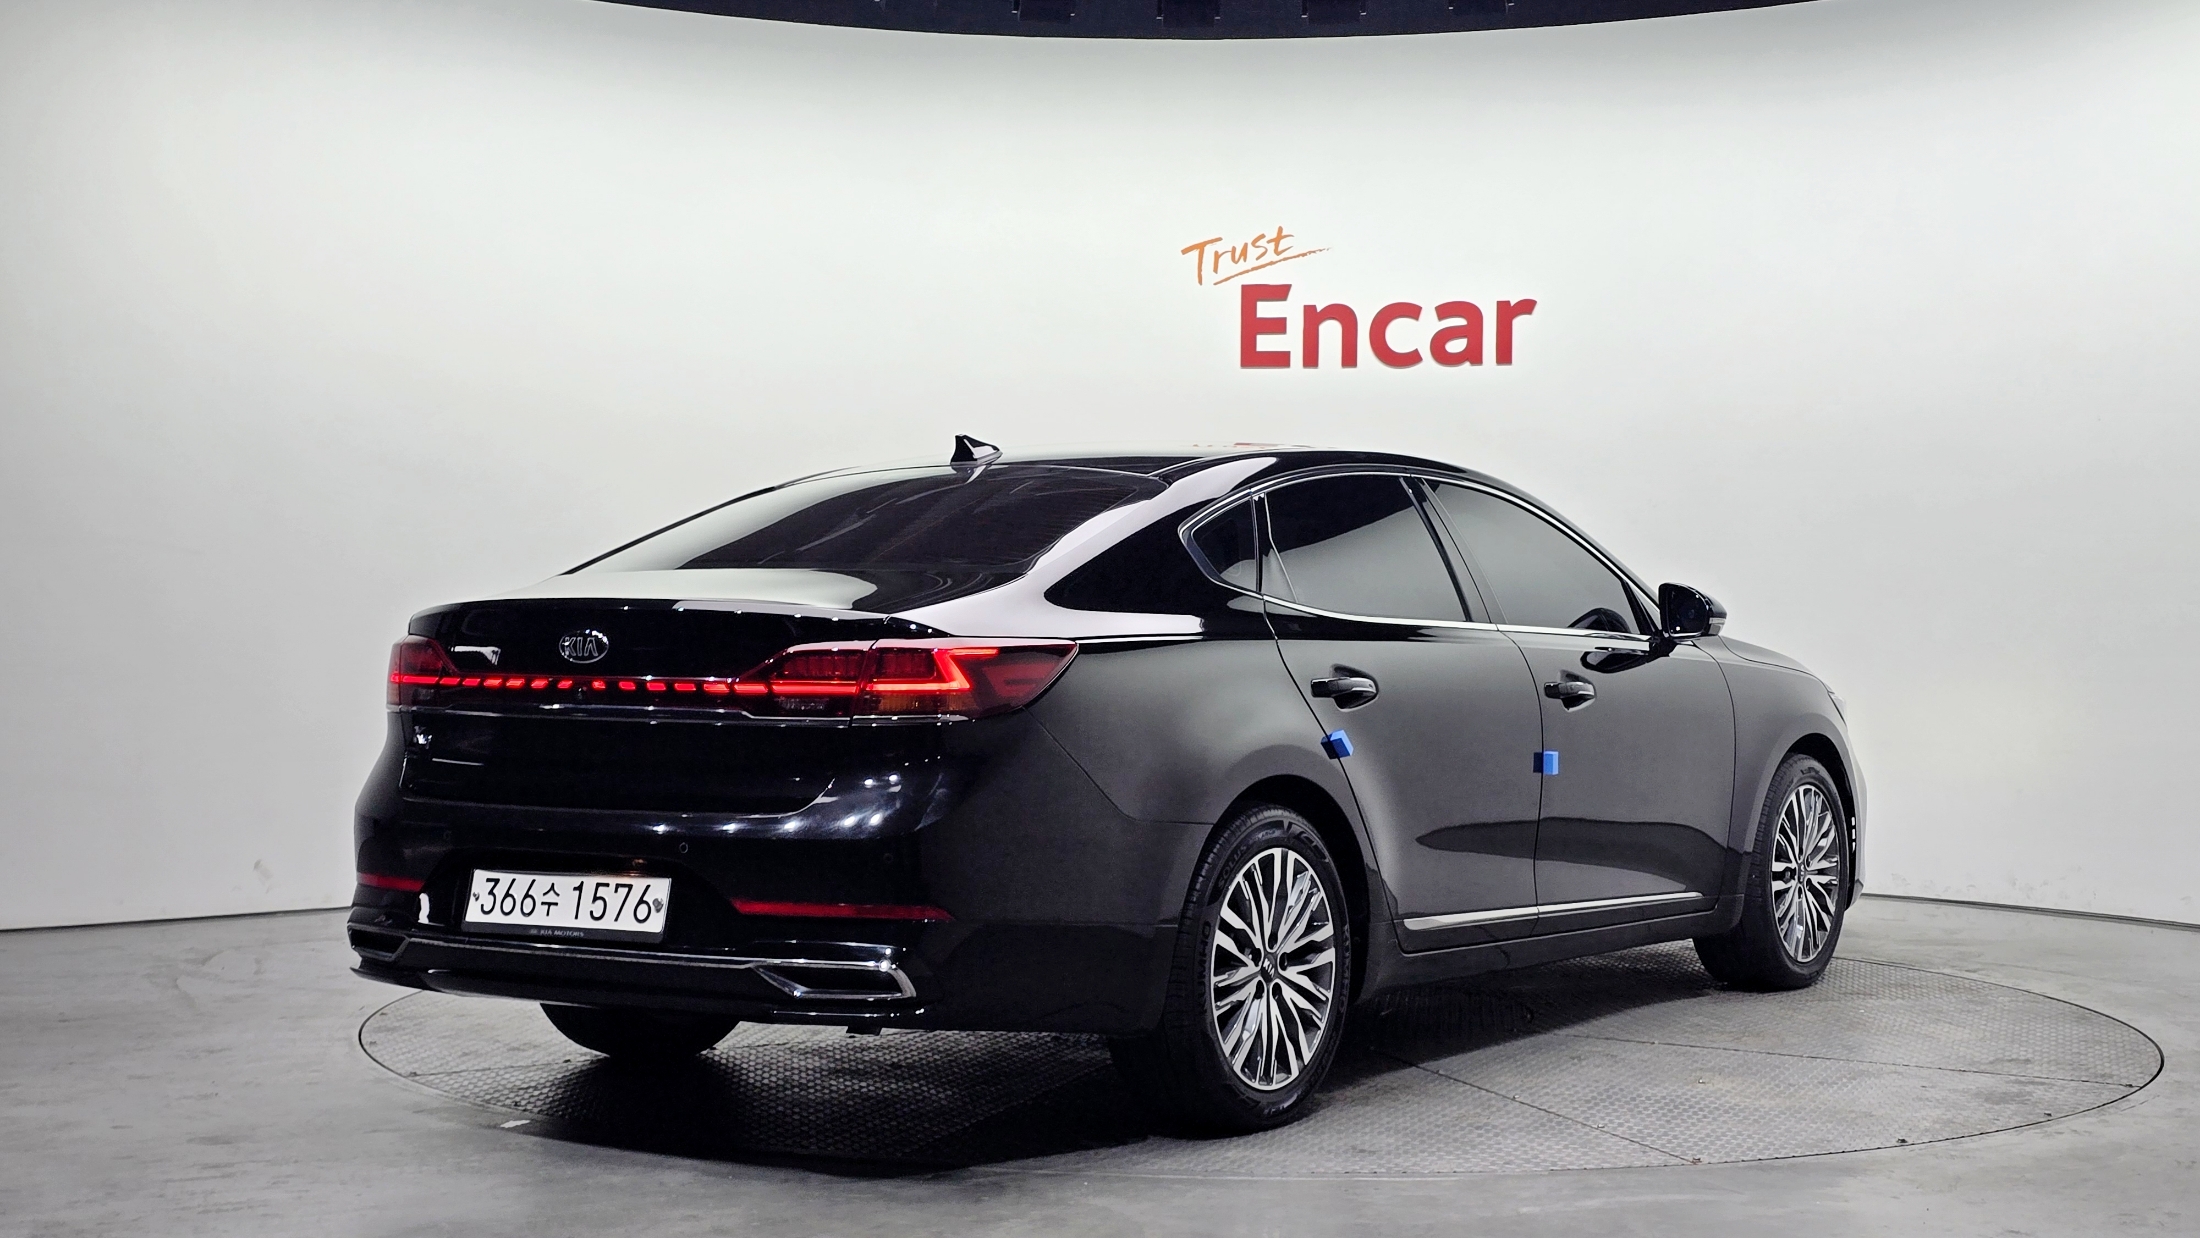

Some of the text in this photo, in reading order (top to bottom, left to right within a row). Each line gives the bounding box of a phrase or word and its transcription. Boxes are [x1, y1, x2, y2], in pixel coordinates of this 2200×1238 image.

[1181, 225, 1295, 286] Trust
[1240, 283, 1538, 369] Encar
[563, 636, 599, 657] KIA
[1217, 844, 1248, 890] SOLUS
[480, 877, 653, 924] 366수 1576
[540, 928, 553, 936] KIA
[553, 929, 585, 938] MOTORS
[1196, 920, 1212, 1016] KUMHO
[1263, 957, 1275, 978] KIA
